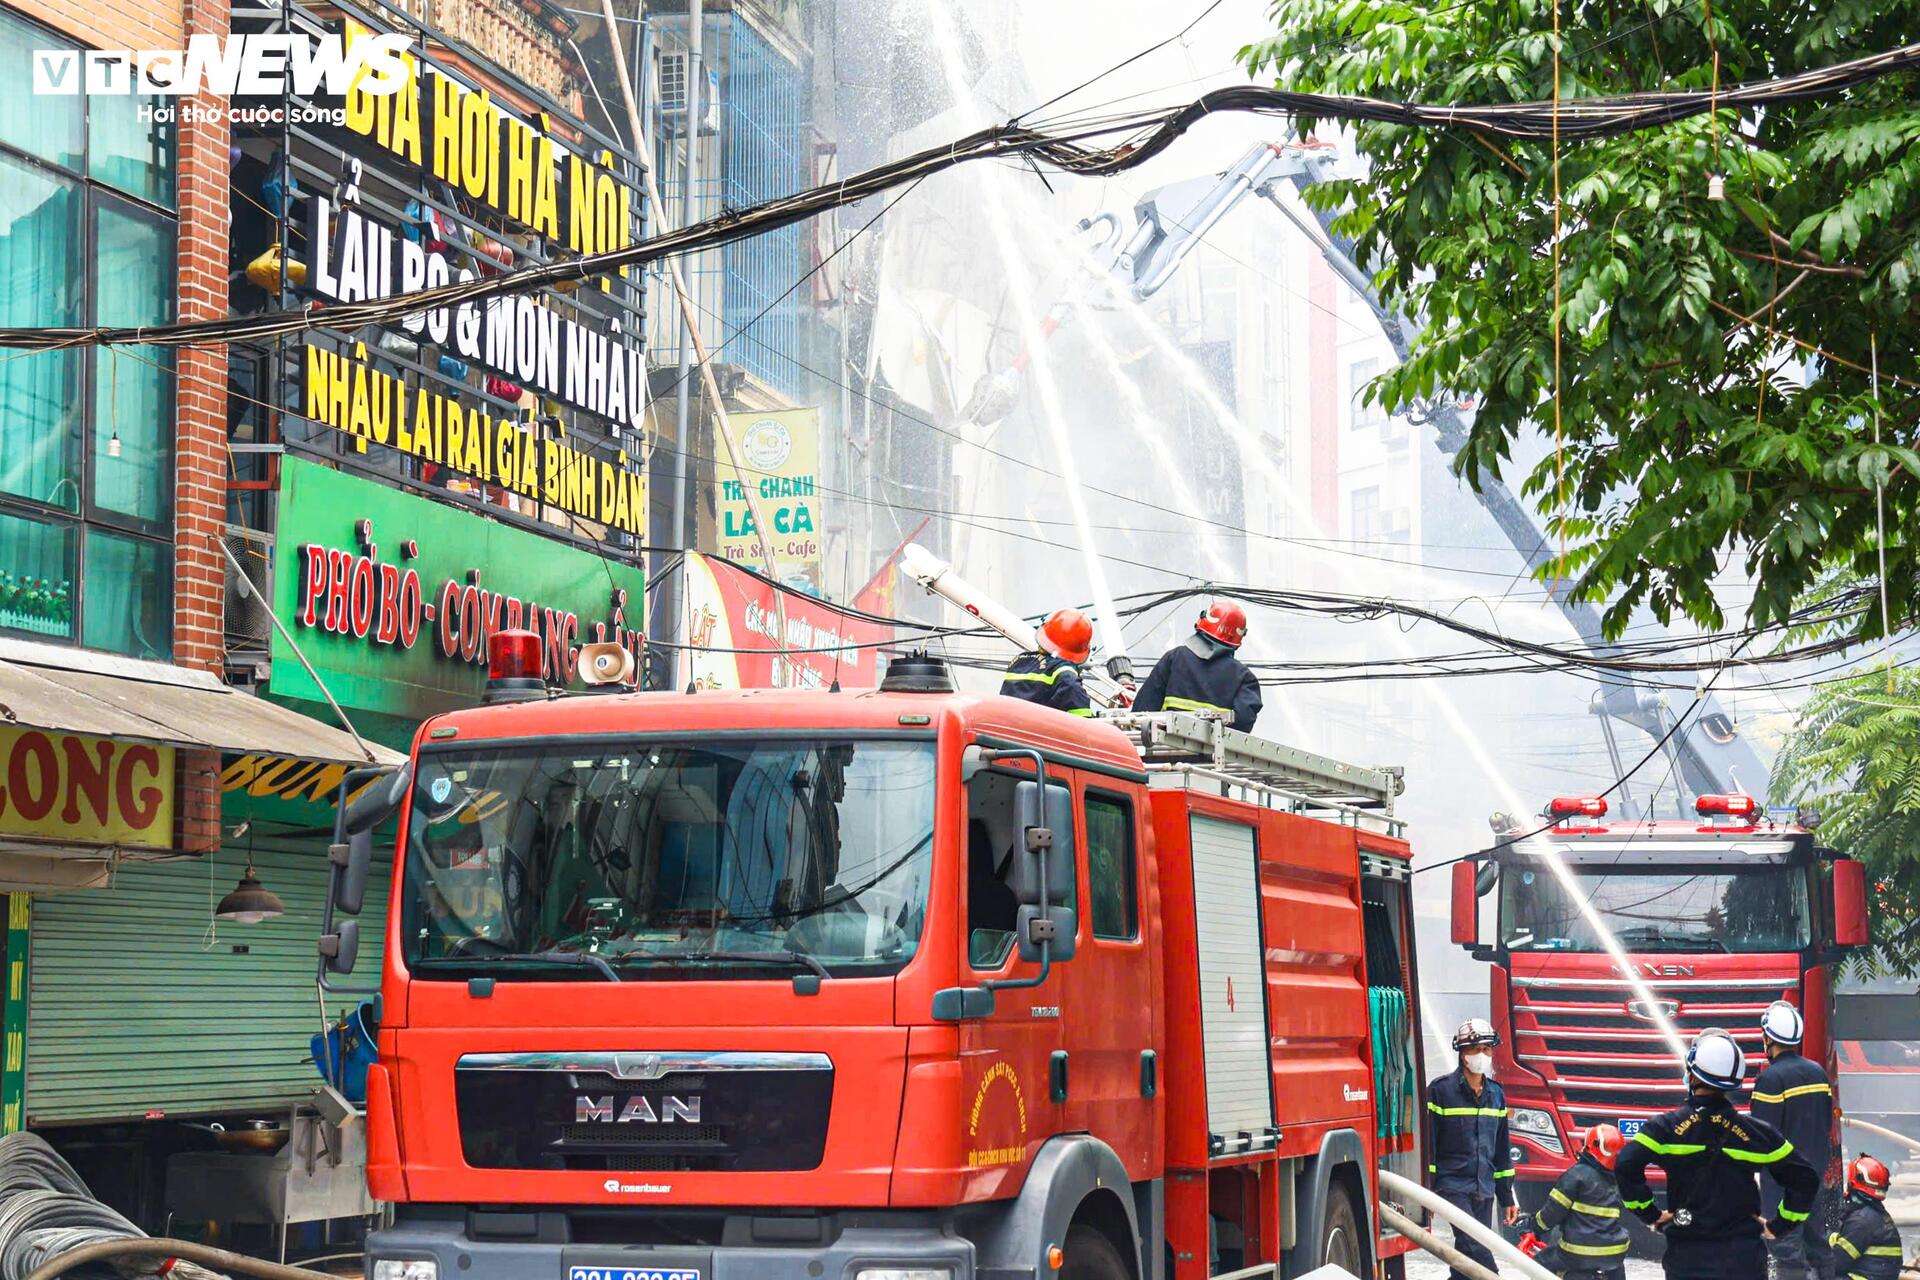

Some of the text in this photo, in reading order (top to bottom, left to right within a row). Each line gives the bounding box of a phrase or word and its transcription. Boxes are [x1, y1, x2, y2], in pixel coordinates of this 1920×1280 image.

[433, 73, 499, 208] HƠI
[508, 112, 559, 241] HÀ
[565, 317, 646, 438] NHẬU
[307, 341, 645, 536] NHẬU LAI RAI GIÁ BÌNH DÂN
[760, 475, 814, 499] CHANH
[774, 502, 814, 535] CÀ
[723, 544, 744, 560] Trà
[787, 540, 817, 559] Cafe
[303, 518, 377, 639] PHỞ
[377, 540, 421, 650] BÒ
[0, 730, 164, 831] ONG
[576, 1096, 700, 1122] MAN
[620, 1183, 673, 1193] rosenbauer
